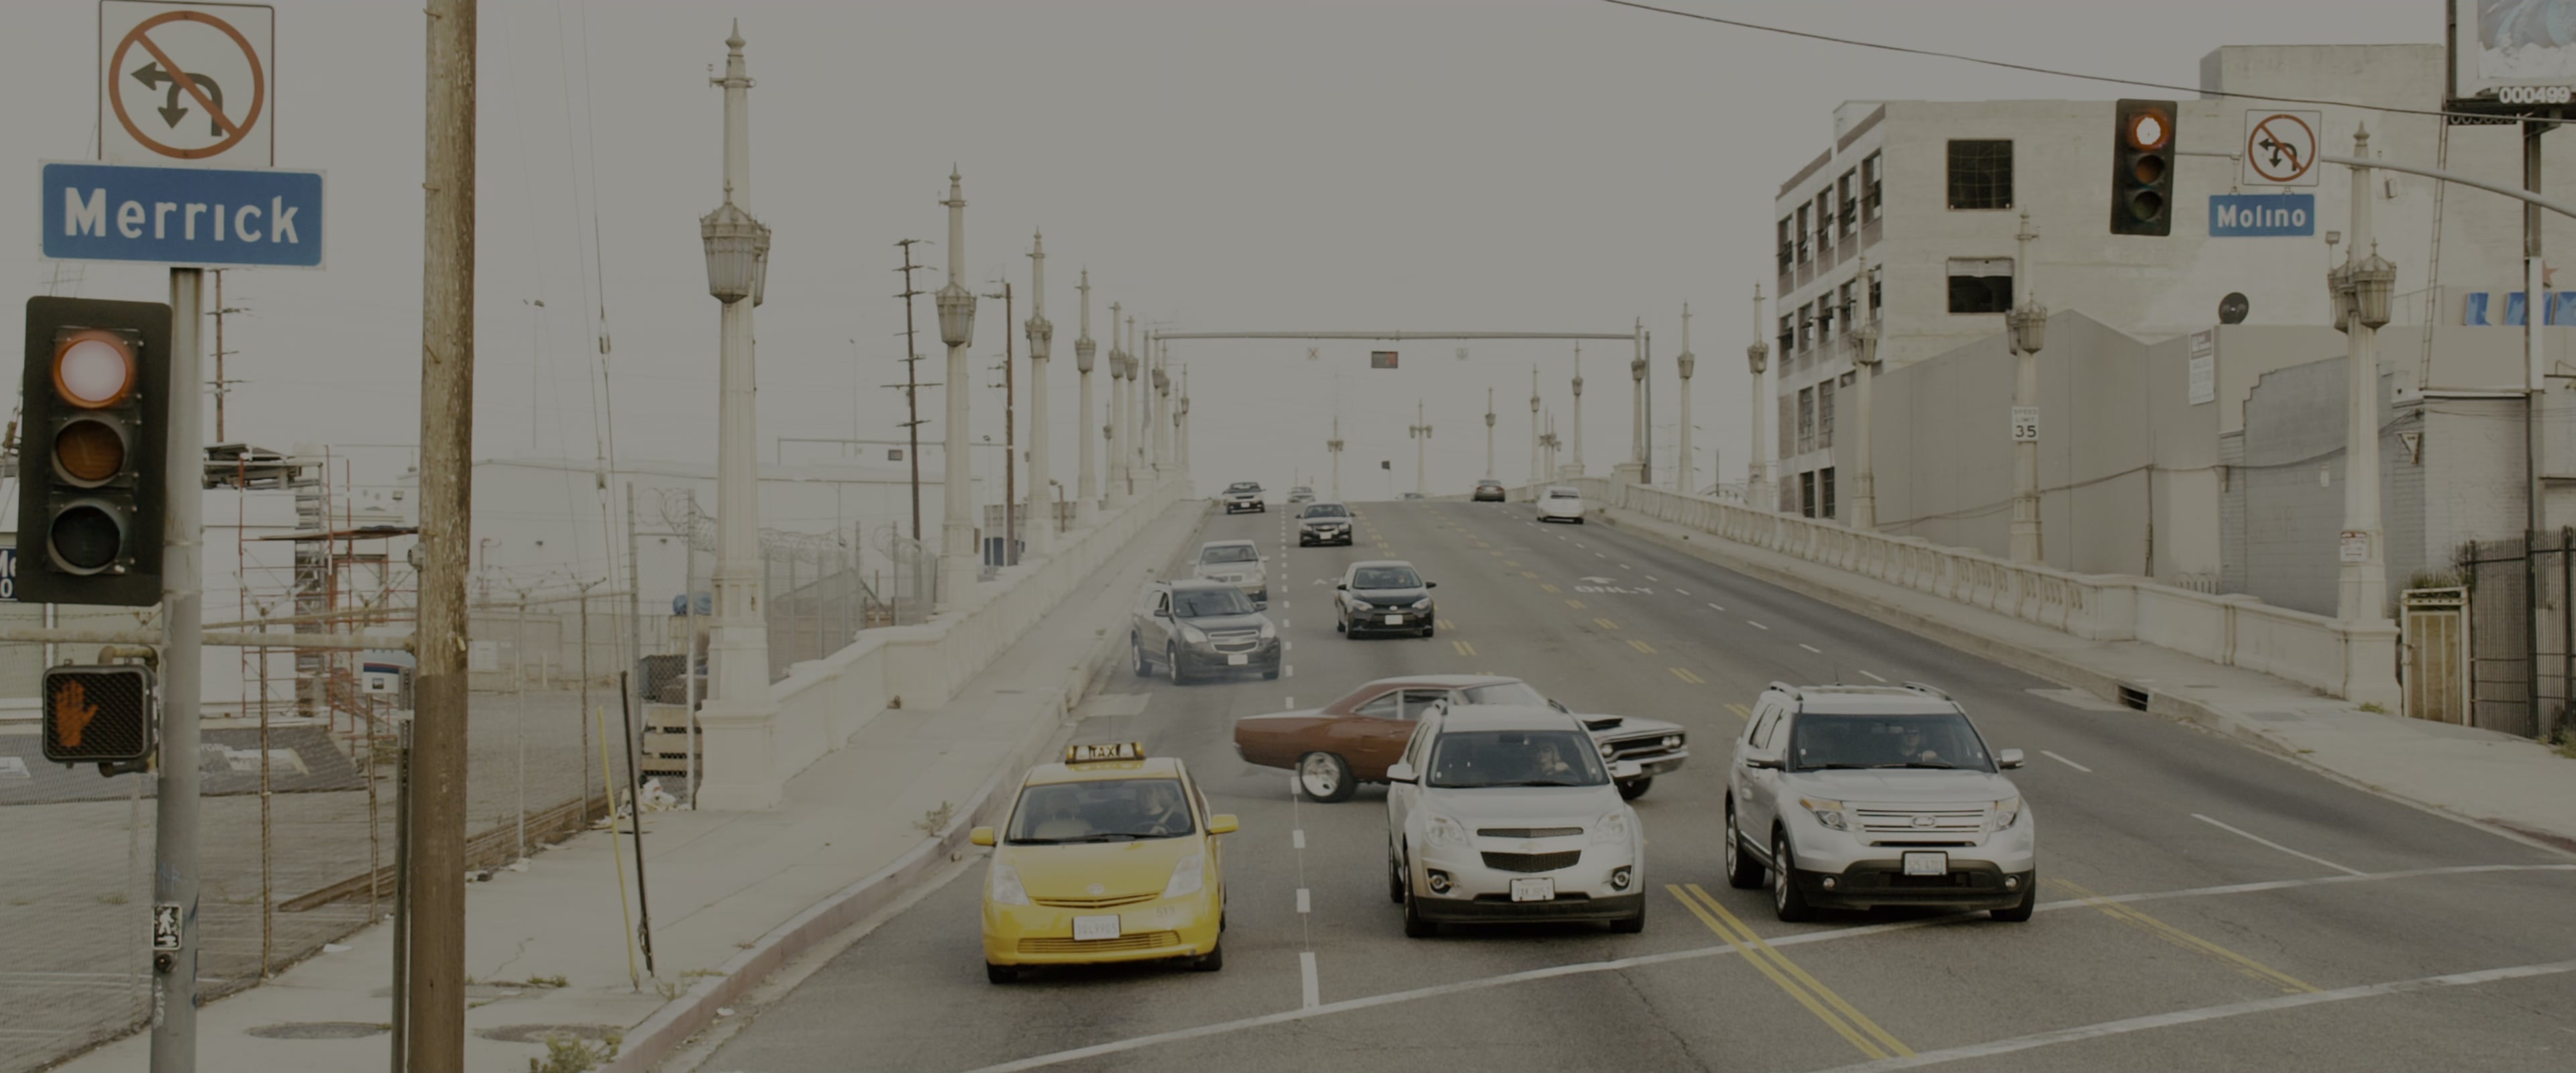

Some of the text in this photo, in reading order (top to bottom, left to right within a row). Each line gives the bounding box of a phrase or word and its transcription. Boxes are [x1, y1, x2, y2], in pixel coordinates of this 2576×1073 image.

[2499, 87, 2571, 104] 000499
[64, 187, 299, 243] Merrick
[2217, 205, 2306, 228] Molino
[2015, 425, 2037, 438] 35
[1090, 744, 1120, 757] TAXI
